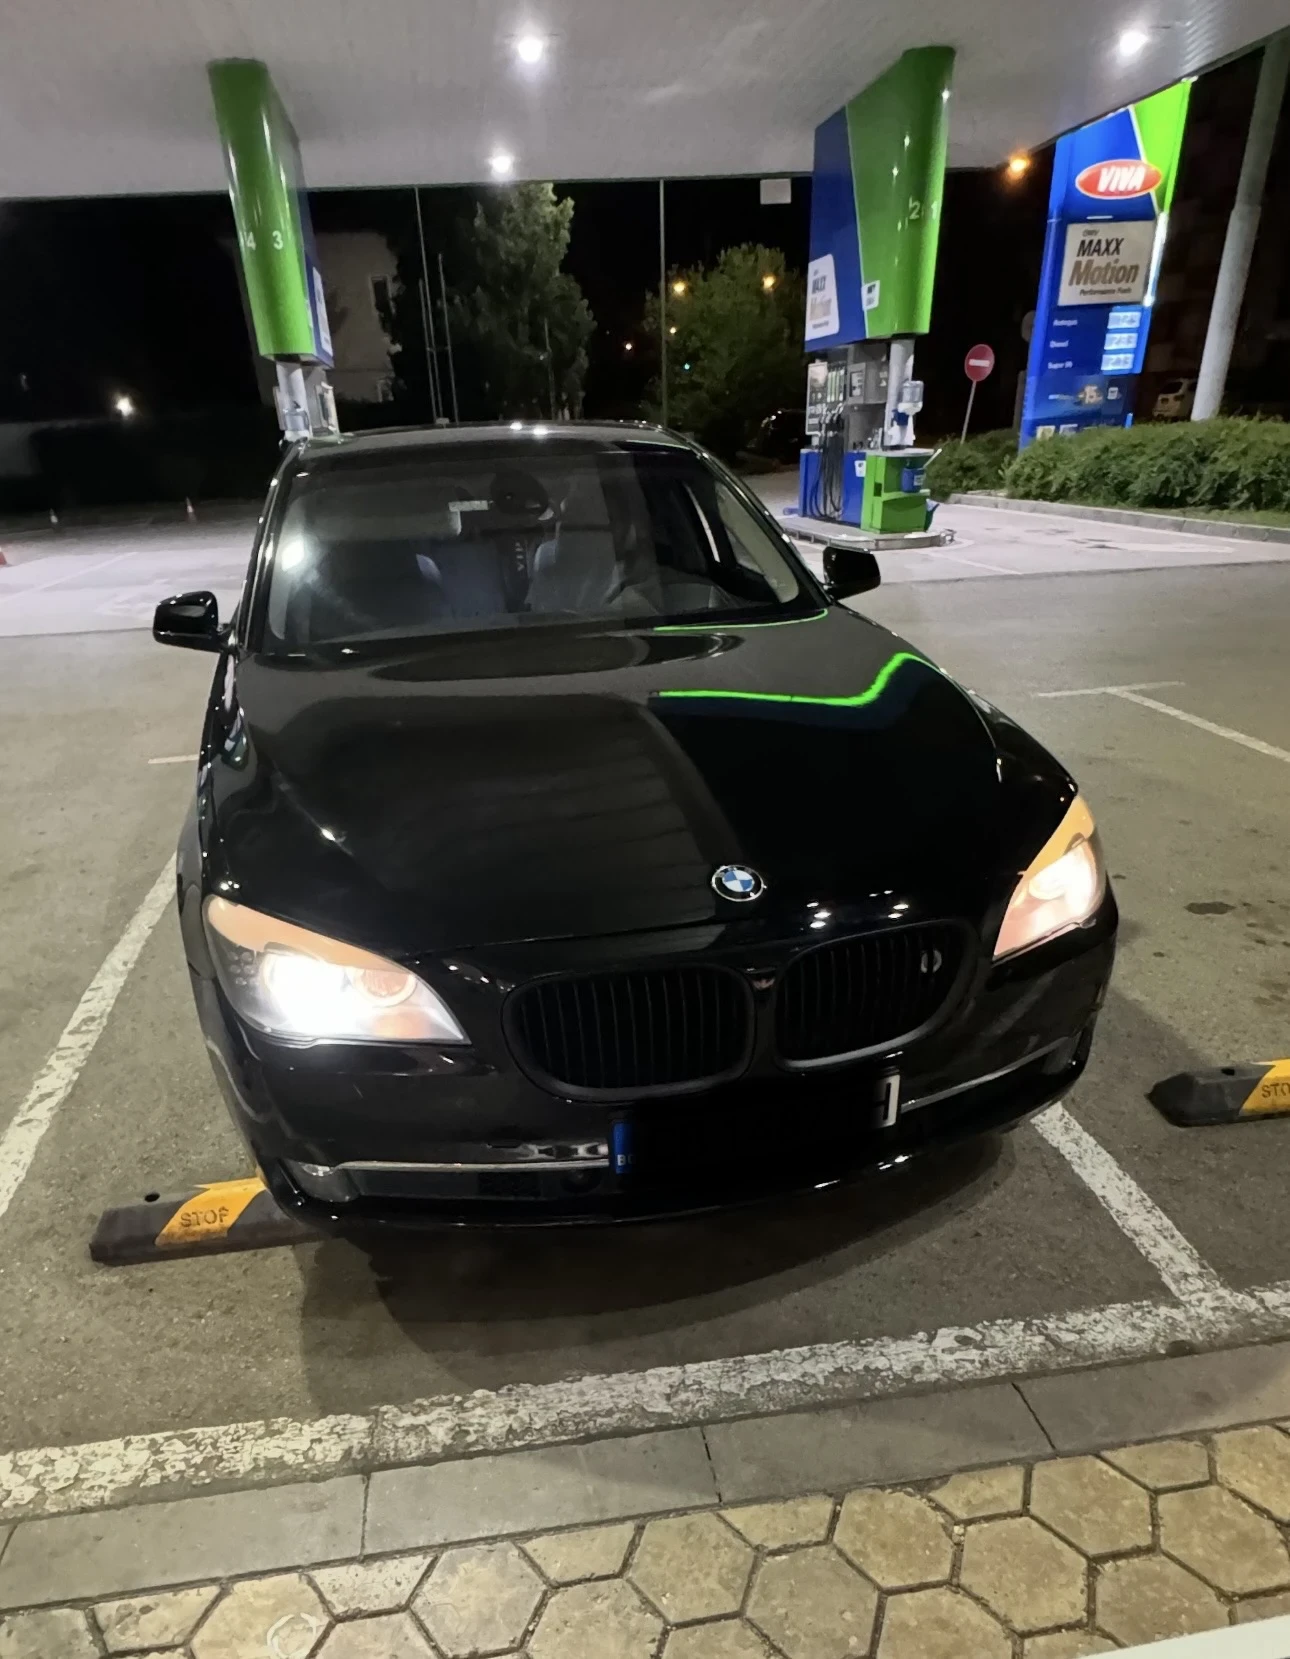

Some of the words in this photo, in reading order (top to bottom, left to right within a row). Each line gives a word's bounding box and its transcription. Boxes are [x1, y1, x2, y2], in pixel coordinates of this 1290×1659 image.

[1097, 165, 1146, 192] VIVA
[909, 200, 921, 220] 2
[247, 231, 257, 251] 4
[272, 230, 284, 250] 3
[1076, 237, 1125, 257] MAXX
[1068, 258, 1140, 286] Motion
[180, 1205, 230, 1228] STOP
